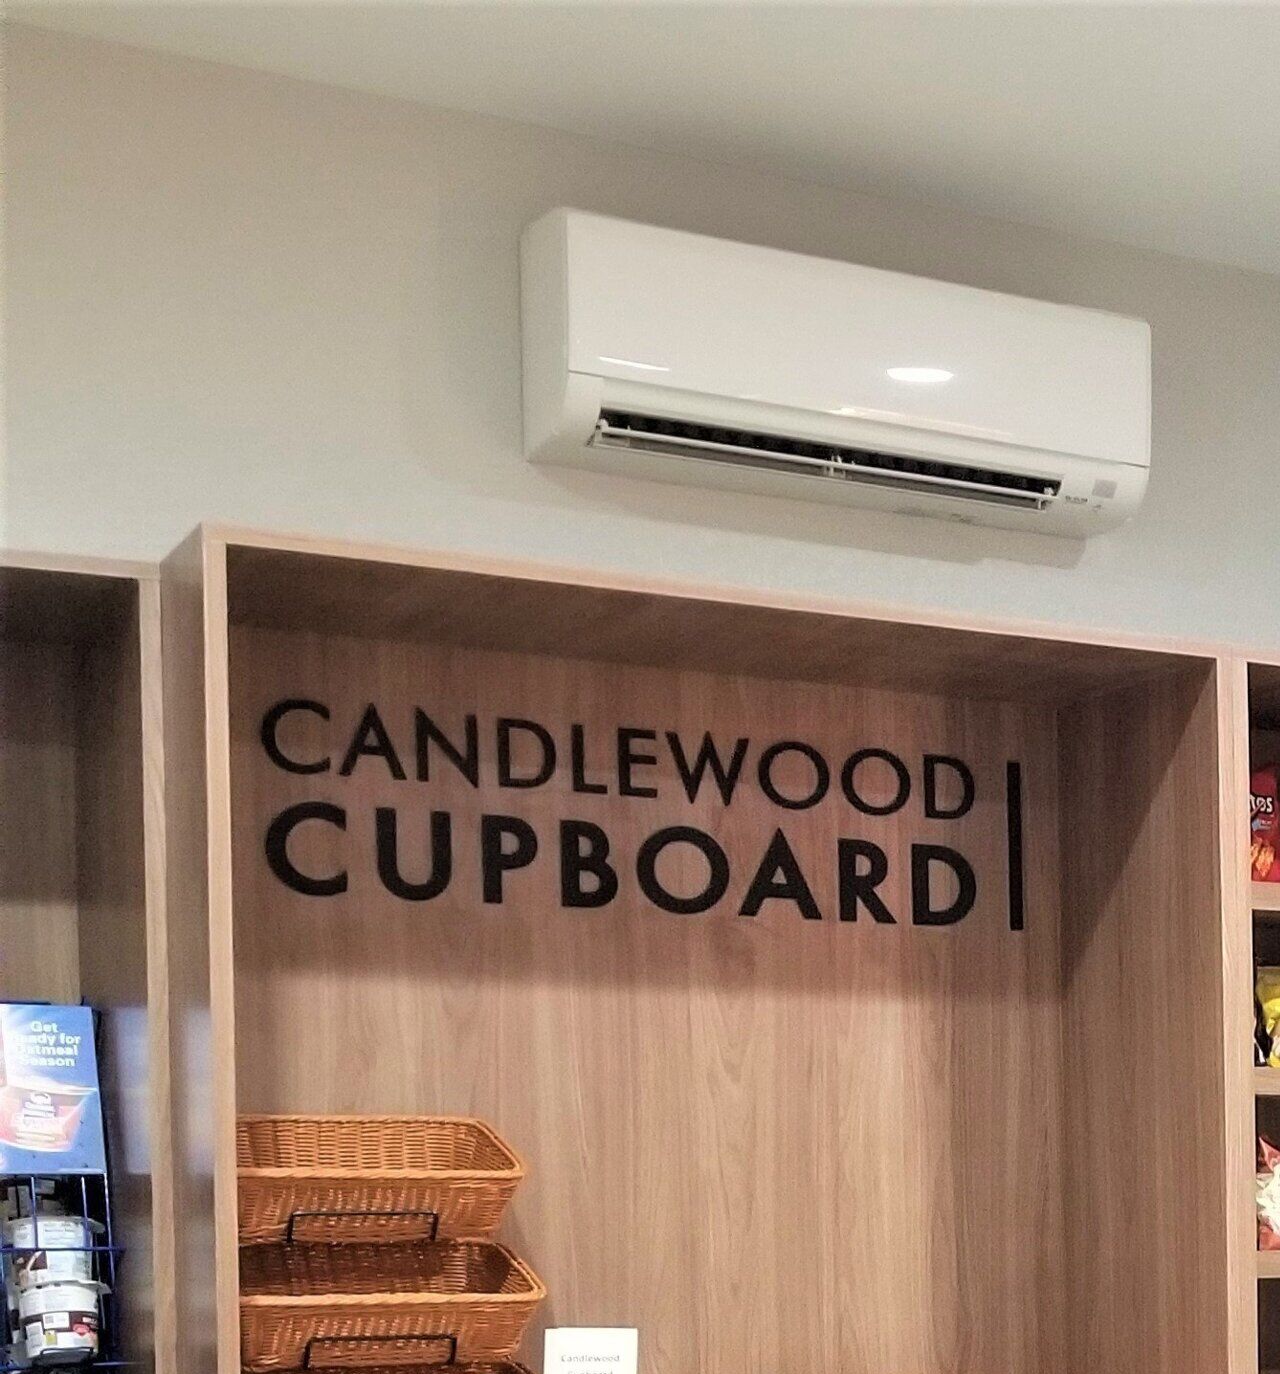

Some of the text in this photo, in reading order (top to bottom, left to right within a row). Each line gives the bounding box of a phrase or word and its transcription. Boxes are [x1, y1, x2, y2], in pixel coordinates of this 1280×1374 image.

[261, 698, 976, 820] CANDLEWOOD
[265, 802, 977, 928] CUPBOARD
[30, 1020, 58, 1032] Get
[60, 1033, 81, 1044] for
[560, 1354, 620, 1362] Candlewood
